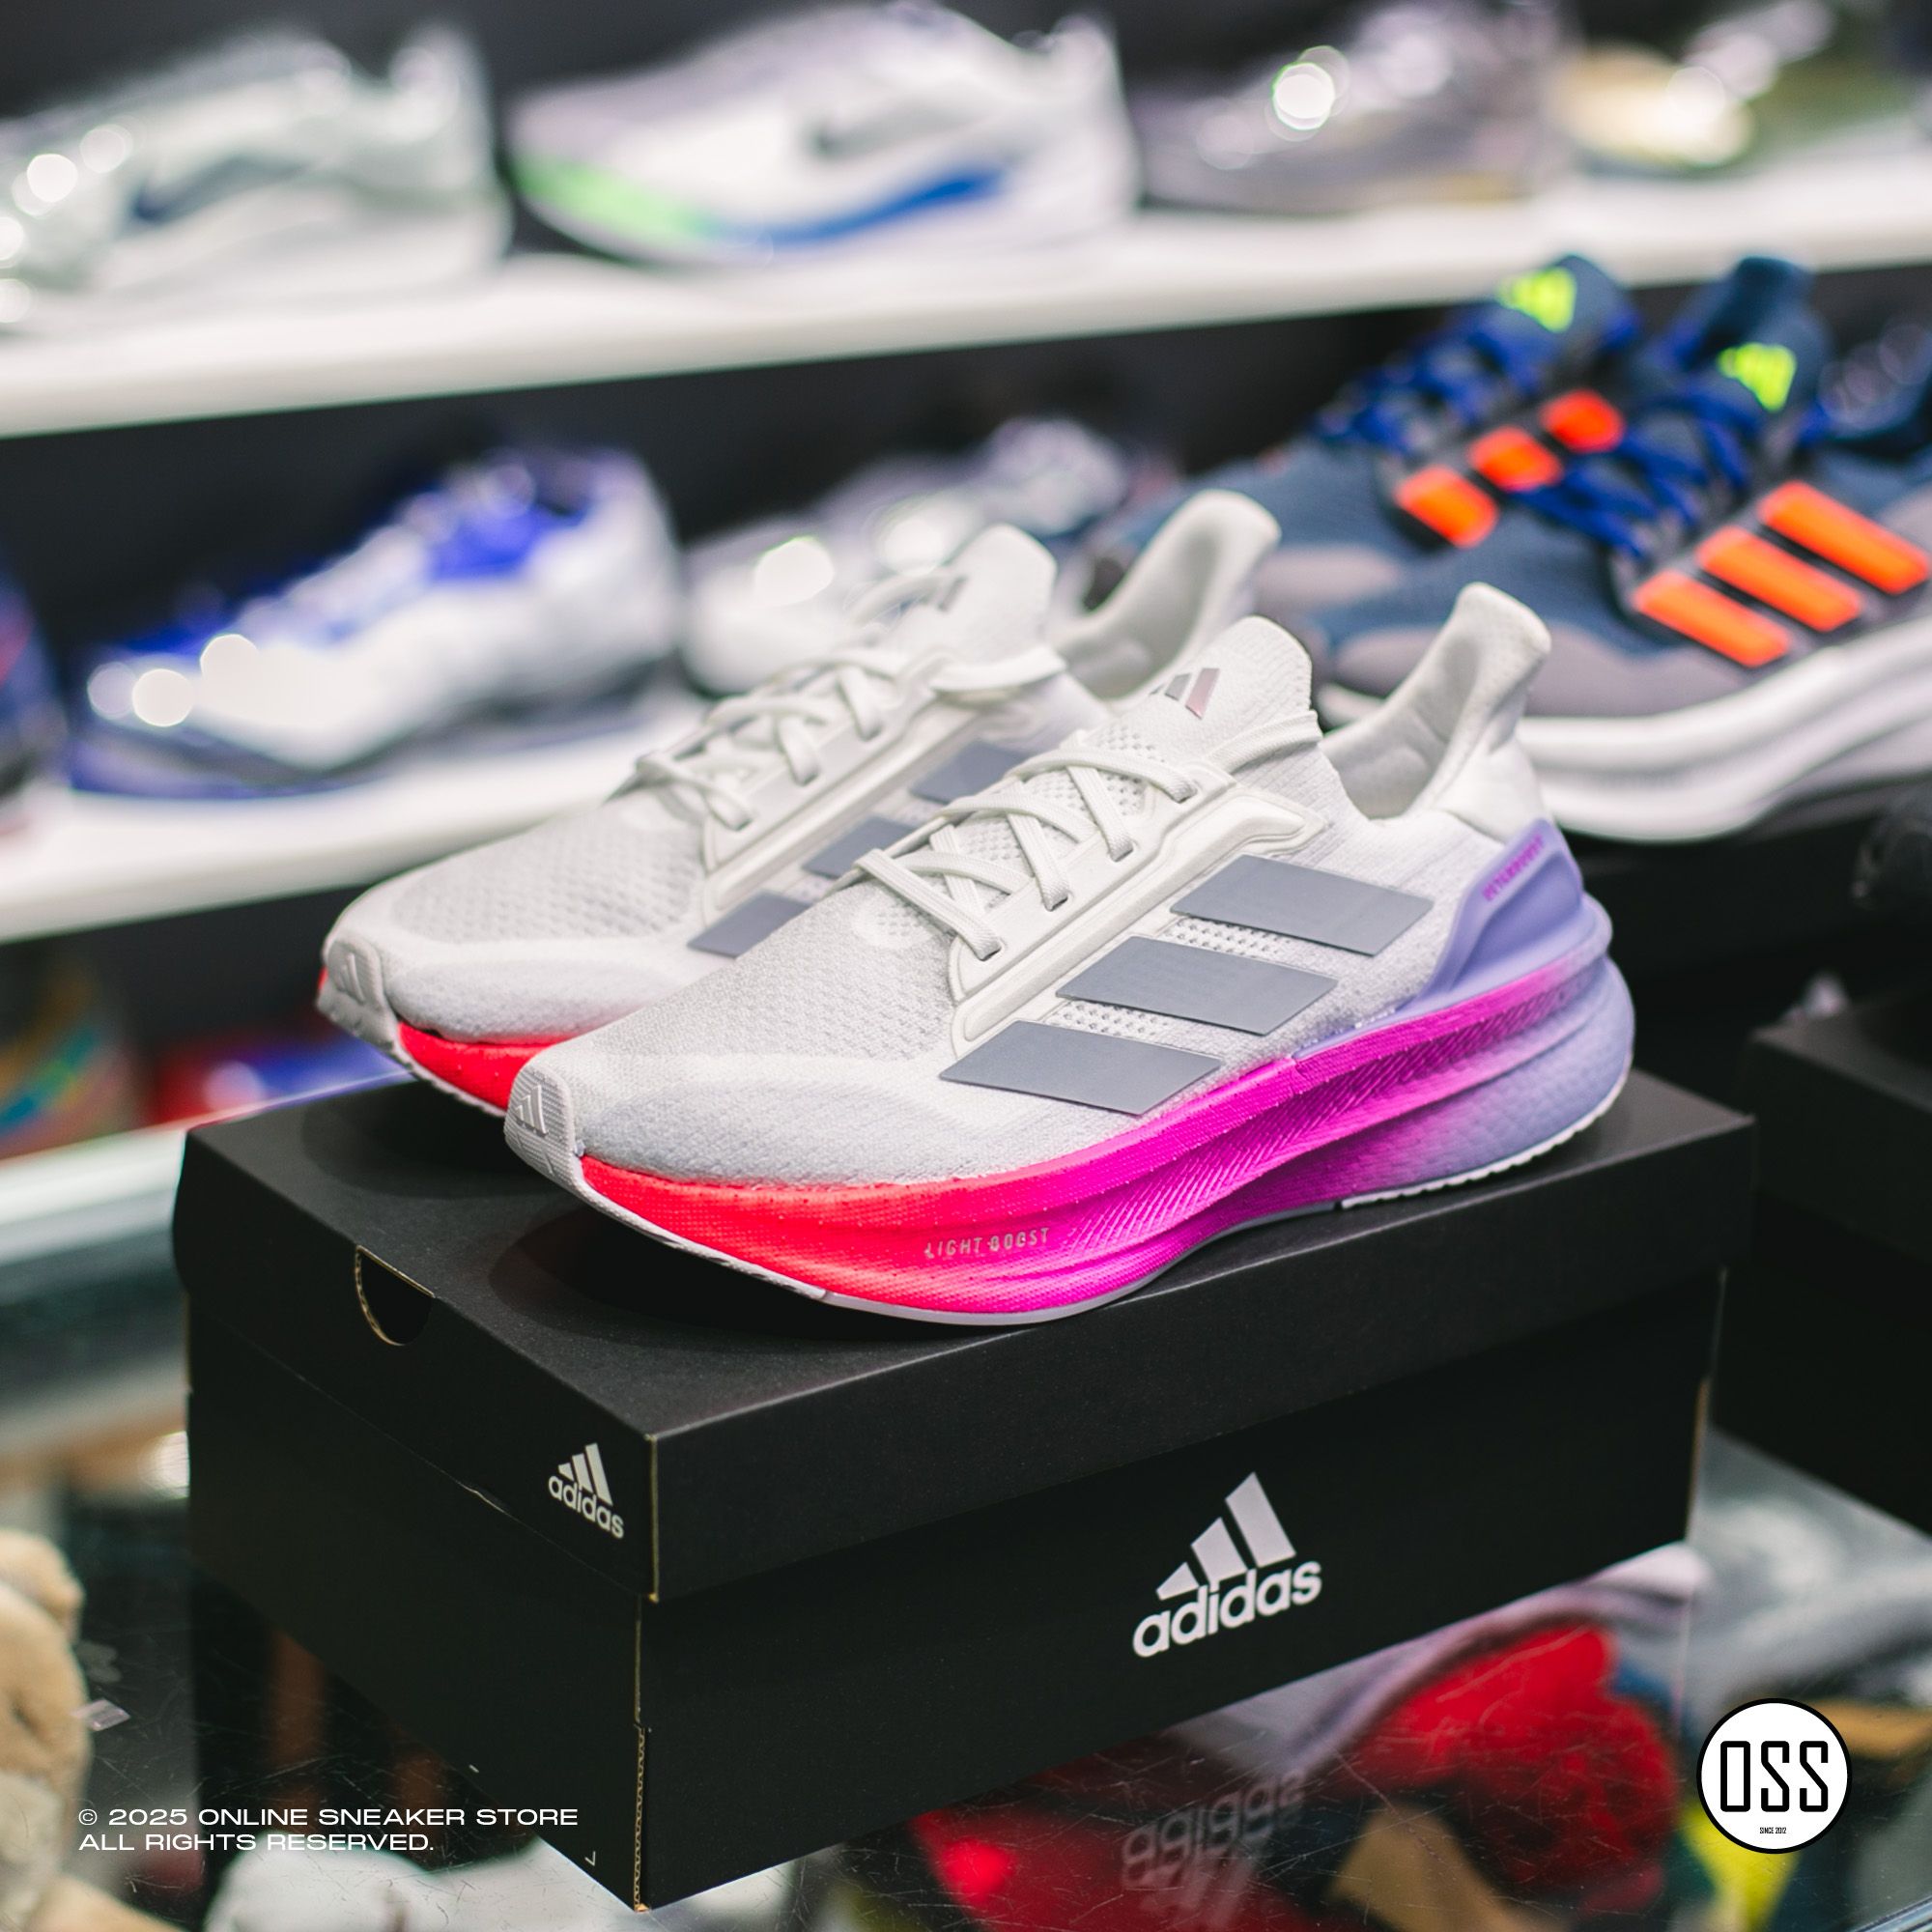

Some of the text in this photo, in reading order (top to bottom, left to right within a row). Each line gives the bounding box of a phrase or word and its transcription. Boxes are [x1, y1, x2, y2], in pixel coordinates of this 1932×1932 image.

[923, 1227, 1050, 1259] LIGHT BOOST
[548, 1475, 624, 1539] adidas
[1132, 1560, 1322, 1658] adidas
